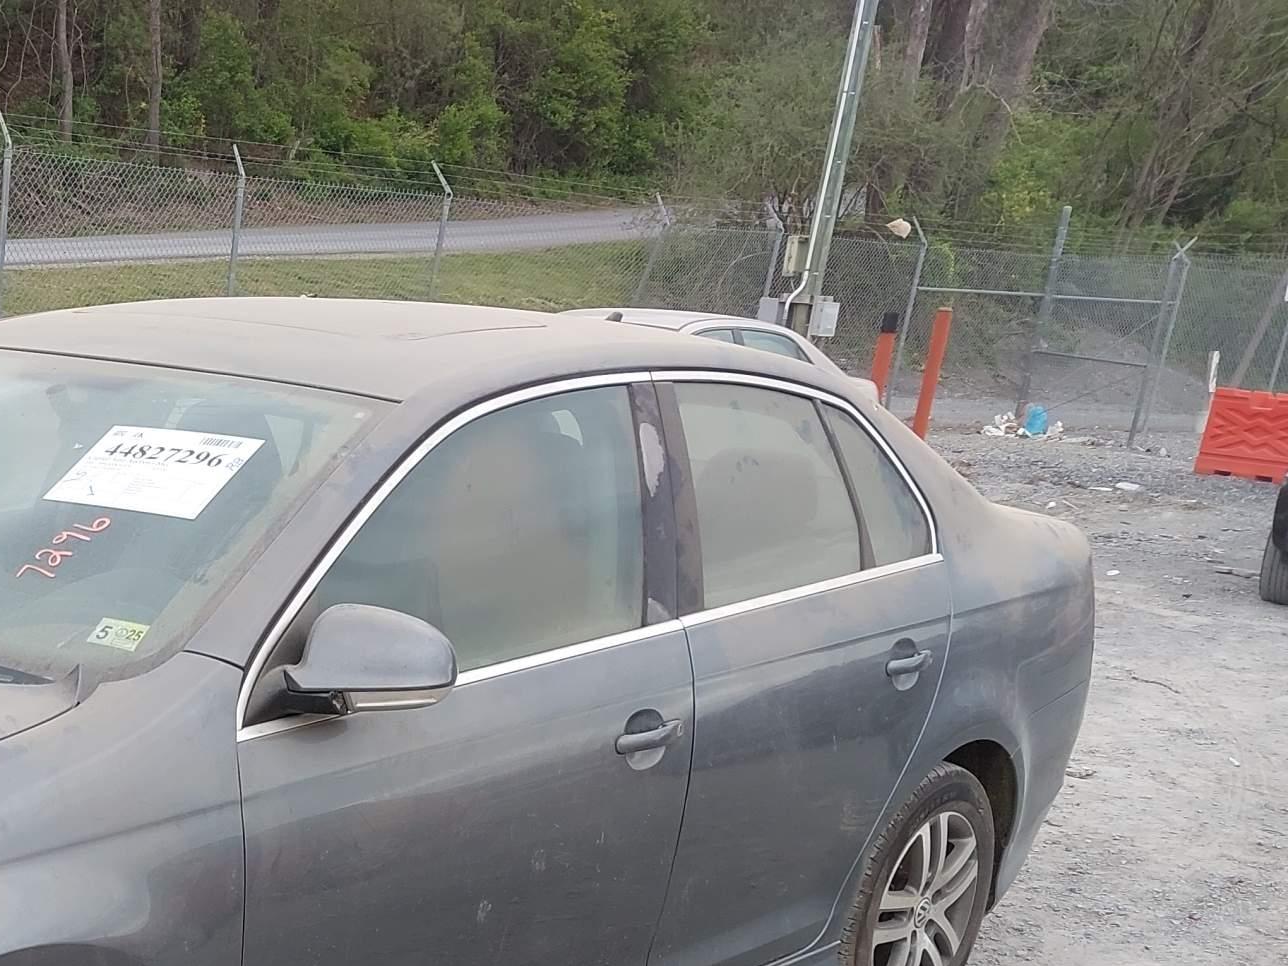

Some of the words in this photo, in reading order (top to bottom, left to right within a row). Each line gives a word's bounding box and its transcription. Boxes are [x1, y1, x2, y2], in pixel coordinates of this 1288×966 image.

[105, 443, 228, 468] 44827296
[15, 517, 111, 579] 7296
[95, 625, 114, 640] 5
[125, 629, 144, 641] 25
